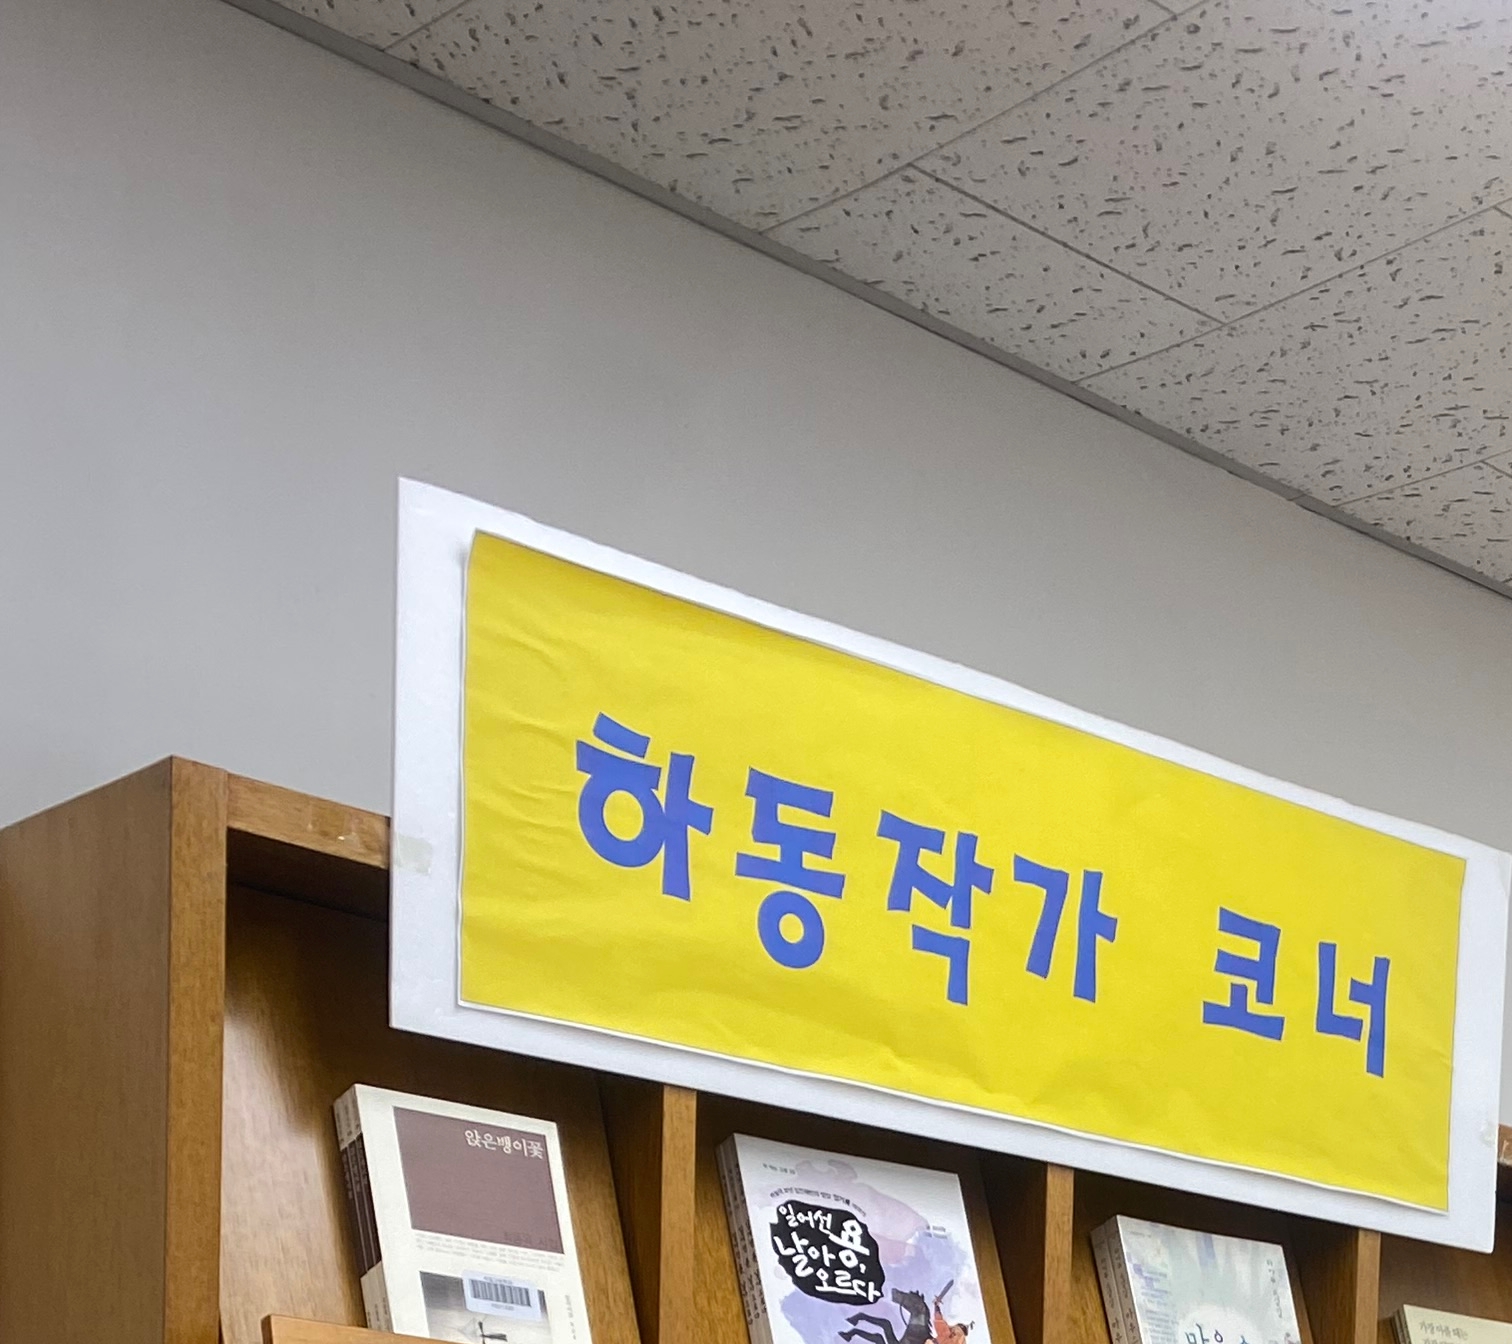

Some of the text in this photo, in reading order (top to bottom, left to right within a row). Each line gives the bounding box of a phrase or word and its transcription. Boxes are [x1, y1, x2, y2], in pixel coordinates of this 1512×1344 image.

[575, 713, 1391, 1078] 하동작가 코너
[464, 1129, 544, 1160] 앉은뱅이꽃
